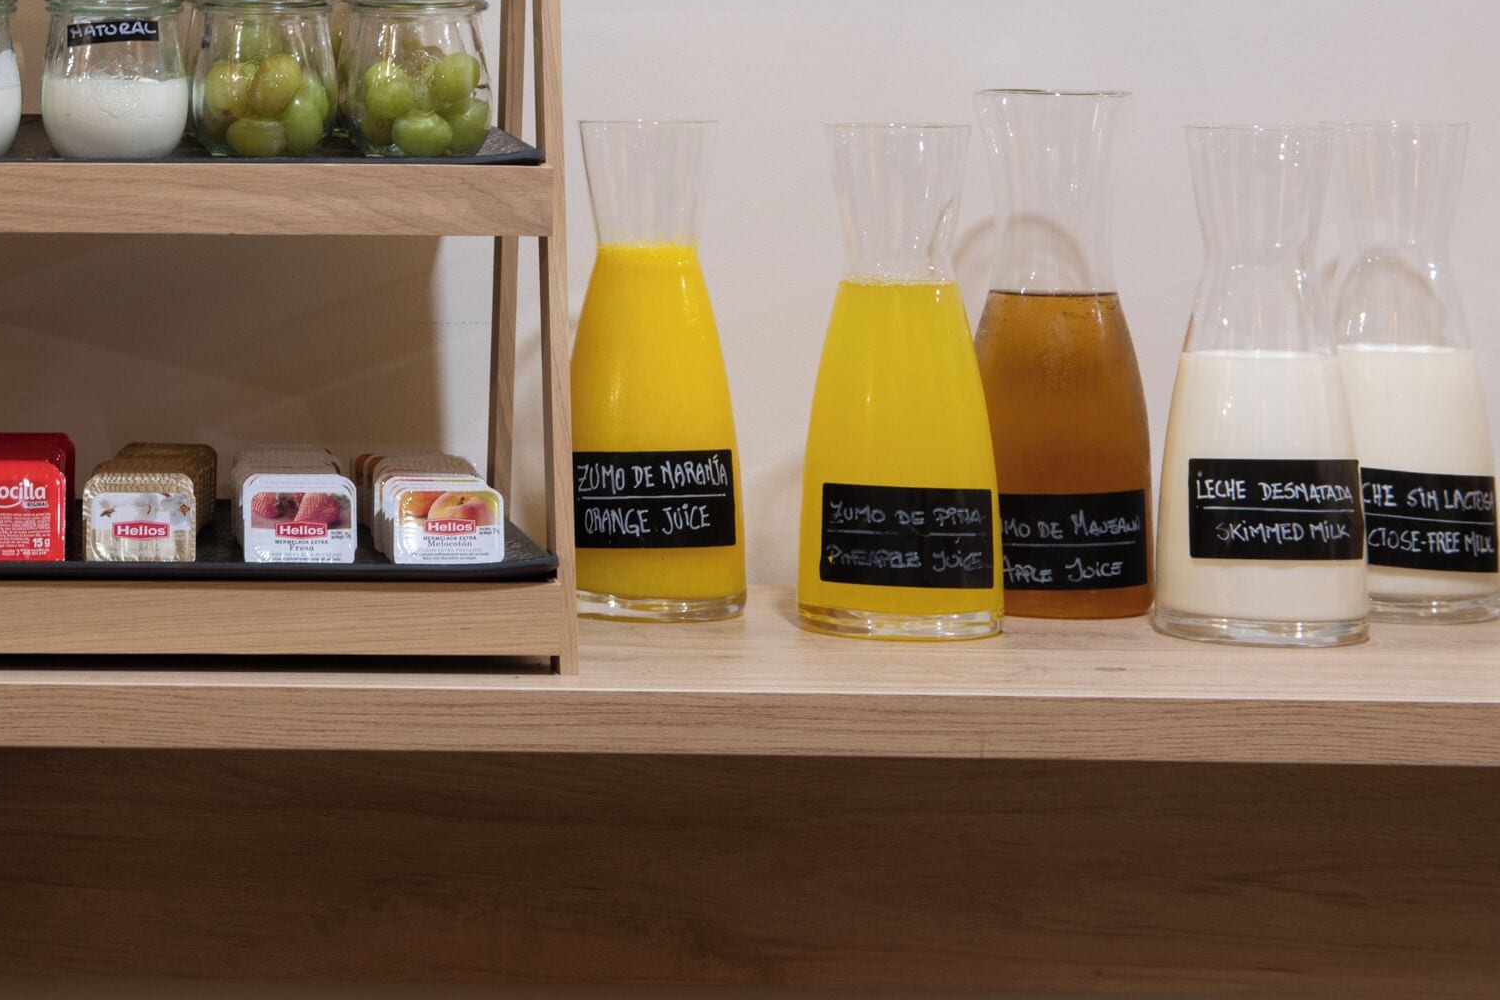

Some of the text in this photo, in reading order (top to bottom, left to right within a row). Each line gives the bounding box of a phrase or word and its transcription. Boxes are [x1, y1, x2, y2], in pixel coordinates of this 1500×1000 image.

[69, 21, 156, 39] NATURAL
[577, 455, 728, 493] ZUMO DE NARANJA
[1196, 476, 1353, 503] LECHE DESNATADA
[1362, 482, 1398, 507] CHE
[584, 507, 651, 536] ORANGE
[830, 501, 886, 524] ZUMO
[894, 510, 924, 525] DE
[116, 525, 166, 537] Helios
[279, 525, 325, 536] Helios
[426, 522, 473, 532] Helios
[1037, 520, 1064, 540] DE
[32, 538, 43, 548] 15
[44, 538, 51, 548] g
[289, 544, 315, 552] Fresa
[1368, 527, 1461, 554] CTOSE-FREE
